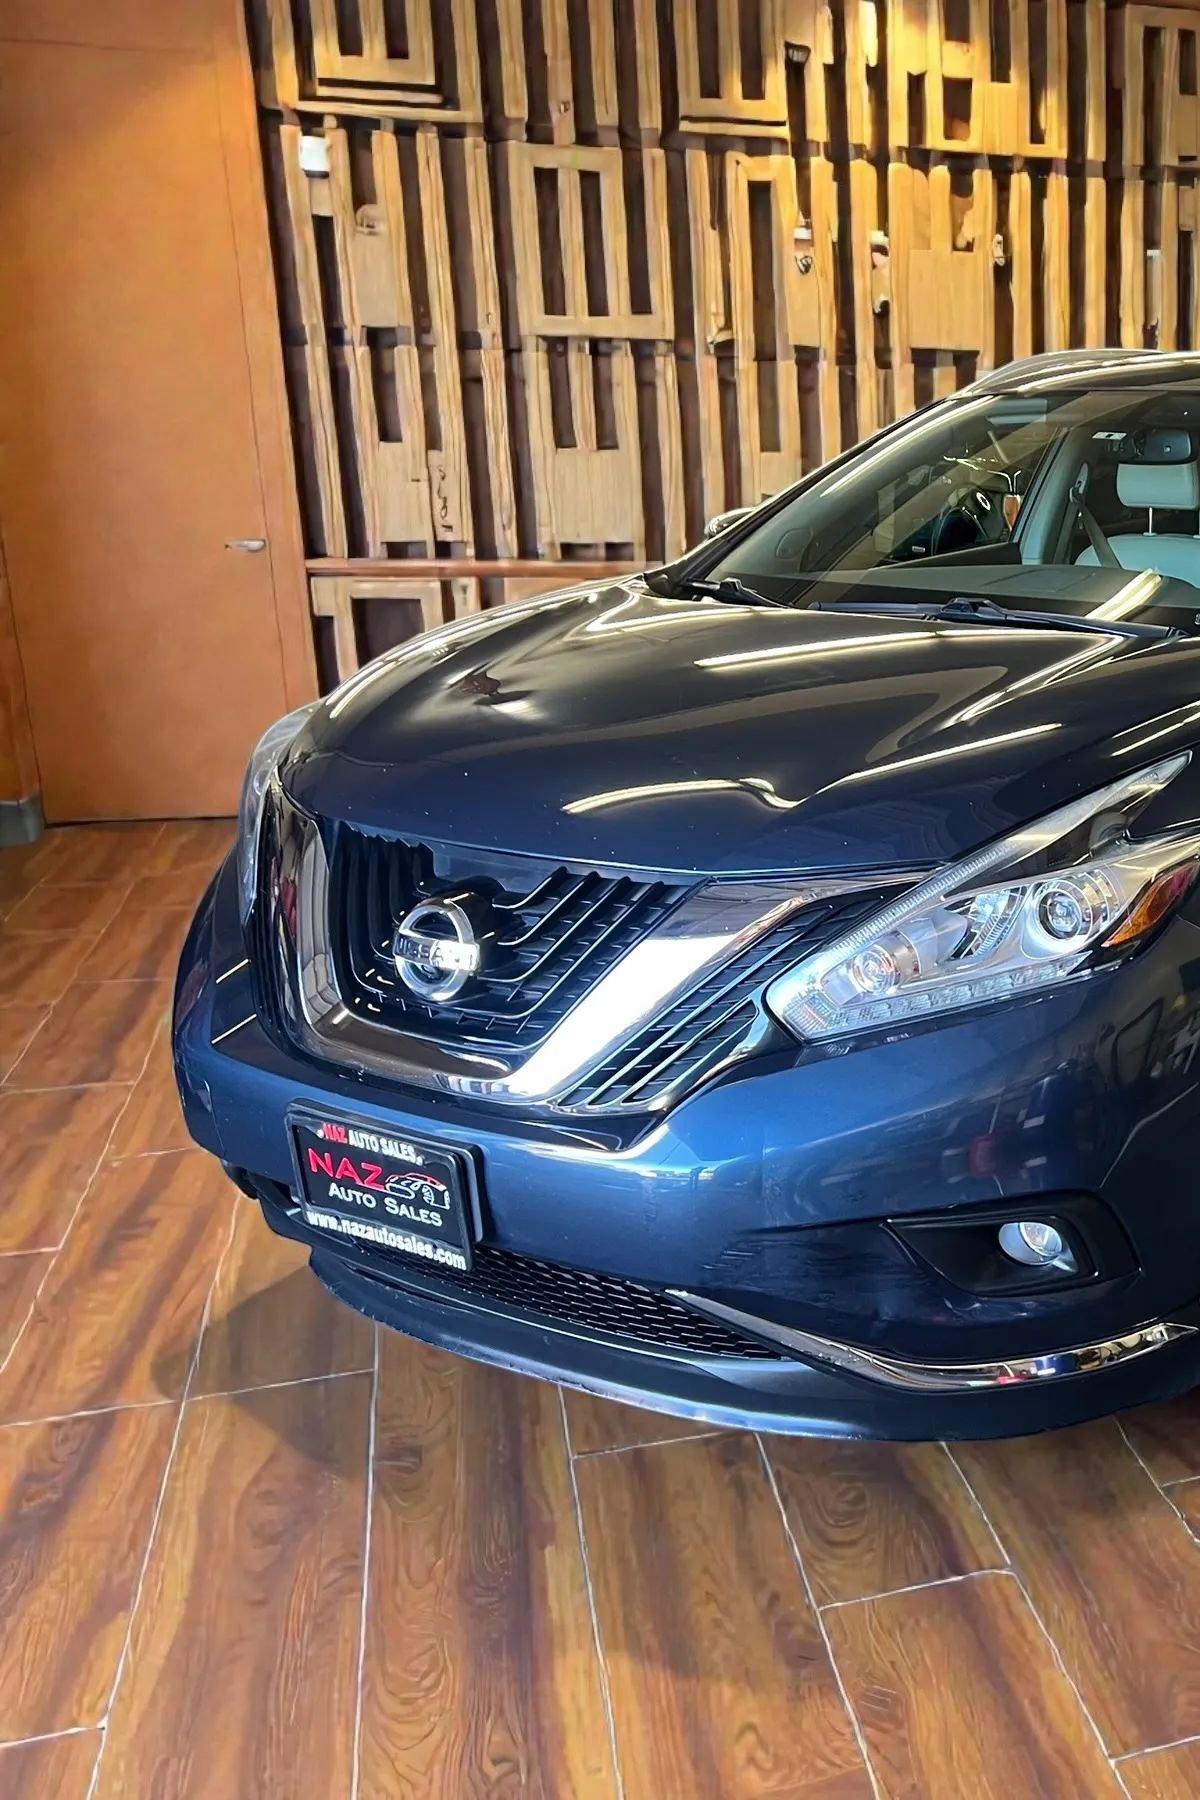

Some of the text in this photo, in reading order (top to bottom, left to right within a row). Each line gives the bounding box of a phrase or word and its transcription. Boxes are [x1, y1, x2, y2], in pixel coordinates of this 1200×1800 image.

[322, 1122, 416, 1163] NAZ AUTO SALES
[308, 1148, 385, 1191] NAZ
[329, 1182, 443, 1227] AUTO SALES
[306, 1211, 467, 1271] www.nazautosales.com
